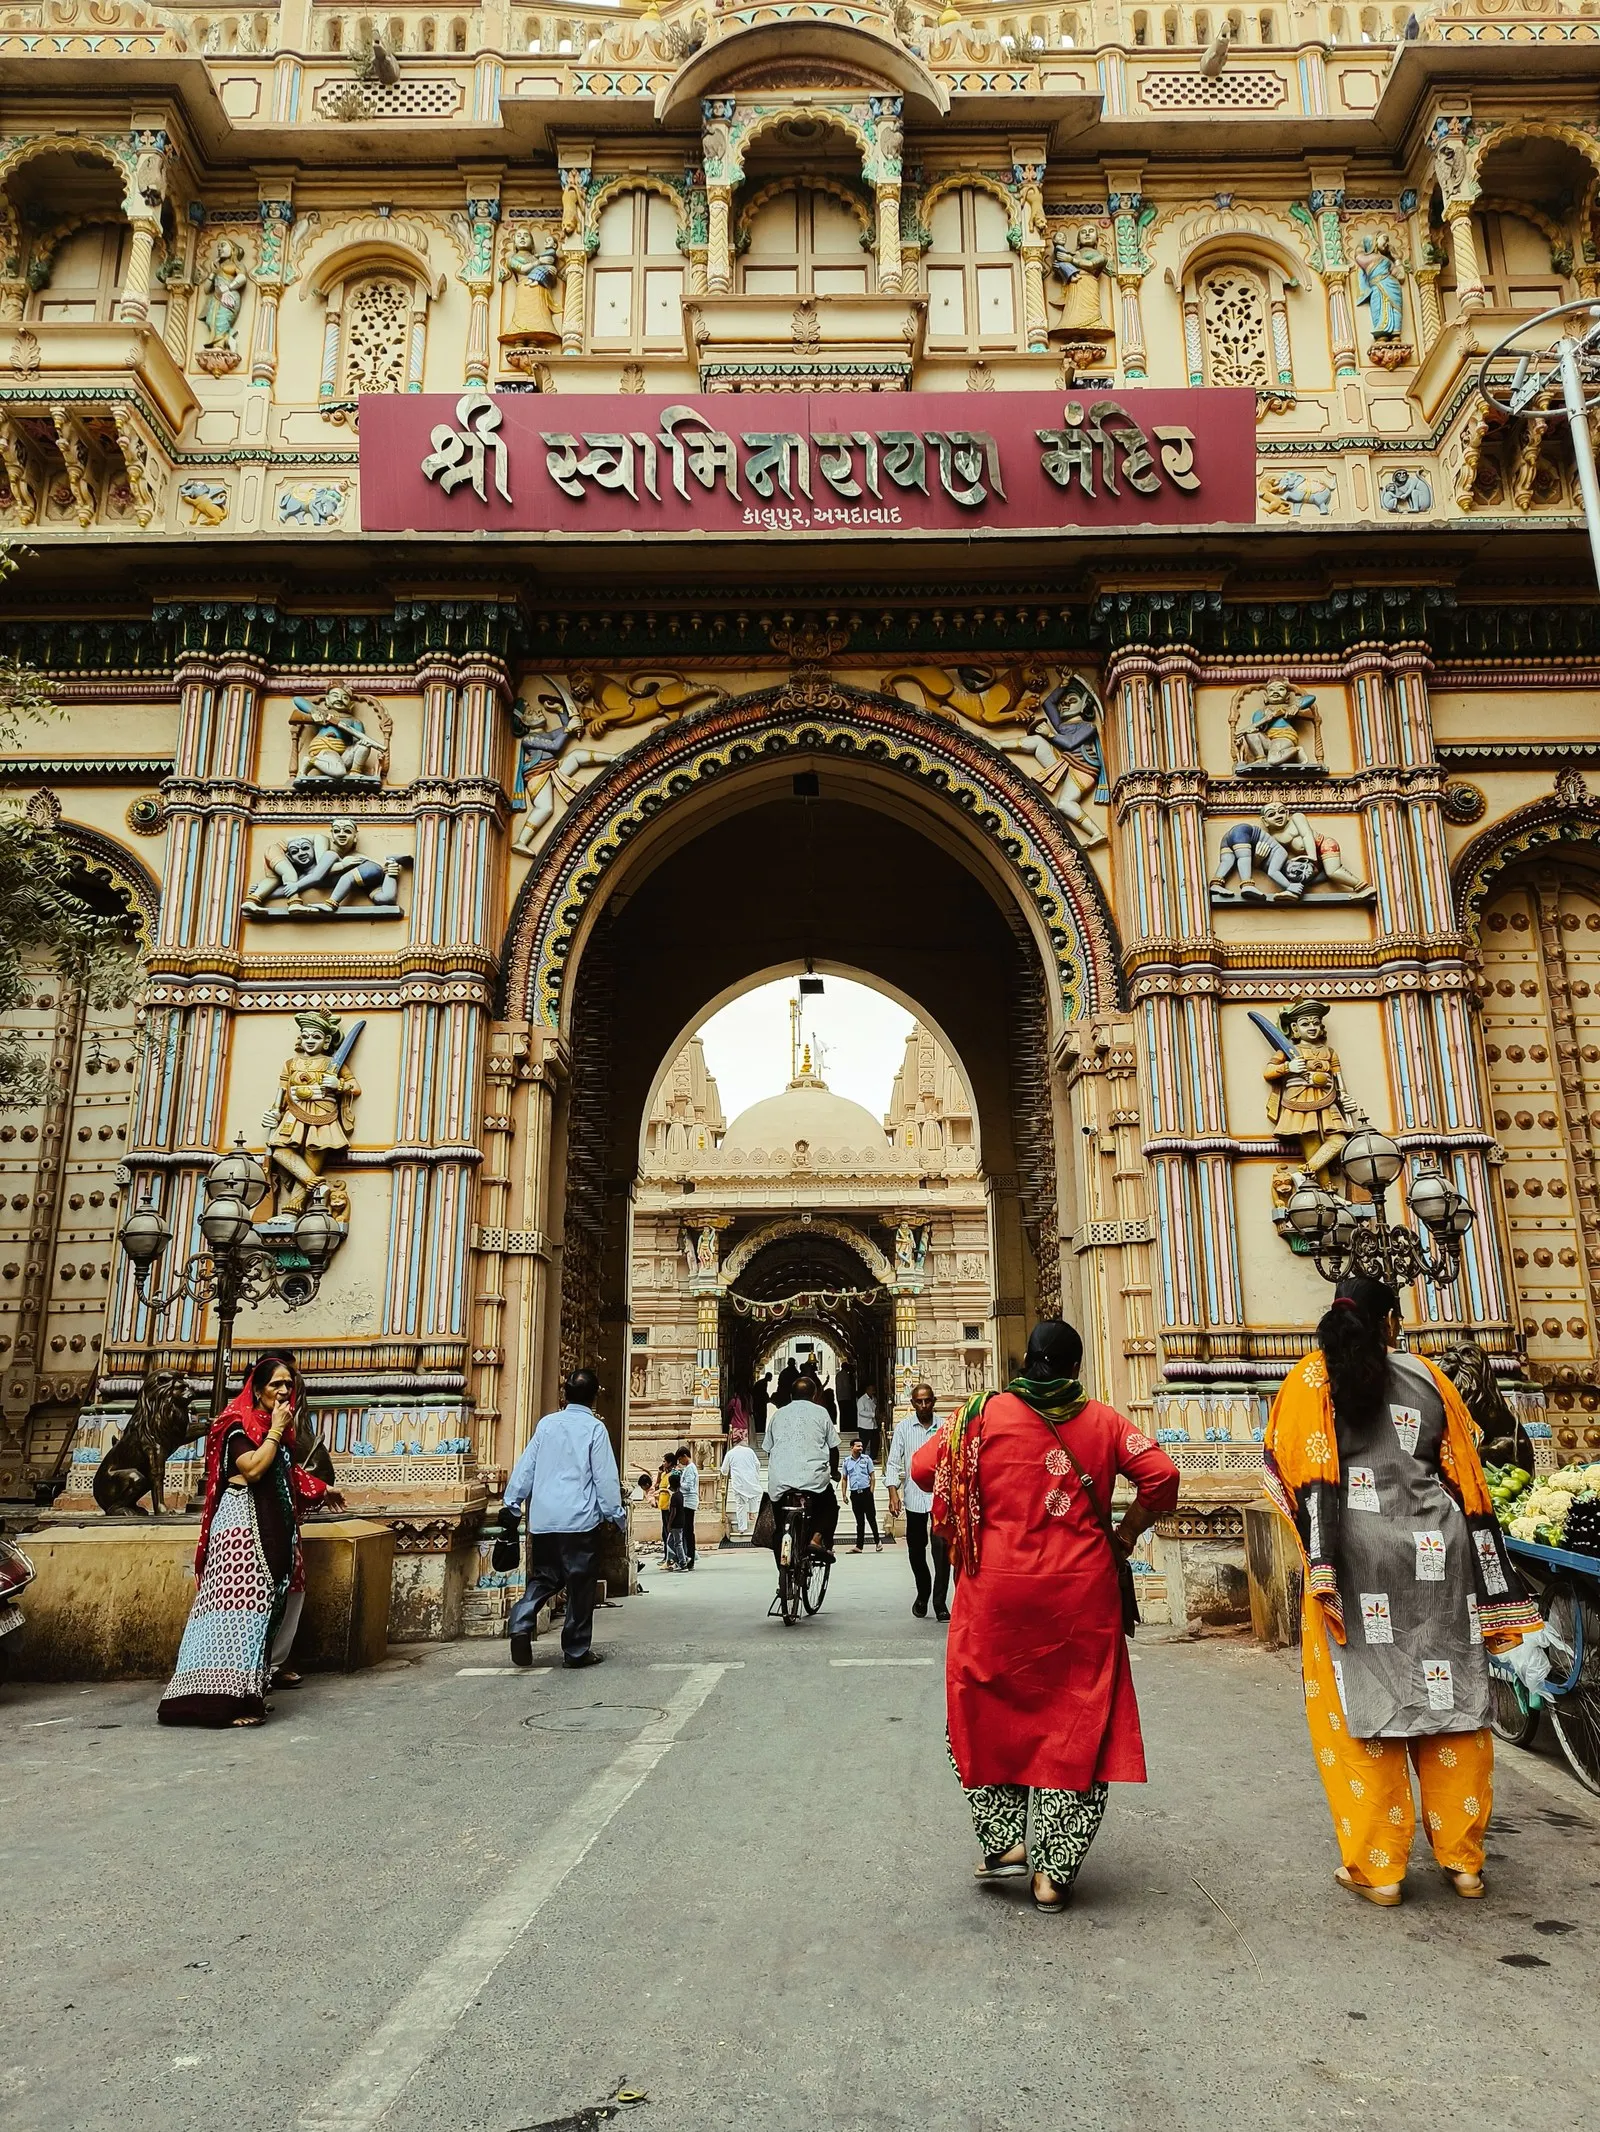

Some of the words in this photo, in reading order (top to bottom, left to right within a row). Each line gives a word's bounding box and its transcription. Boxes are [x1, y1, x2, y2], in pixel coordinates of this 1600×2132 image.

[421, 394, 512, 503] श्री
[539, 404, 1008, 506] स्वामिनारायण
[1034, 401, 1201, 498] मंदिर
[813, 506, 902, 524] અમદાવાદ
